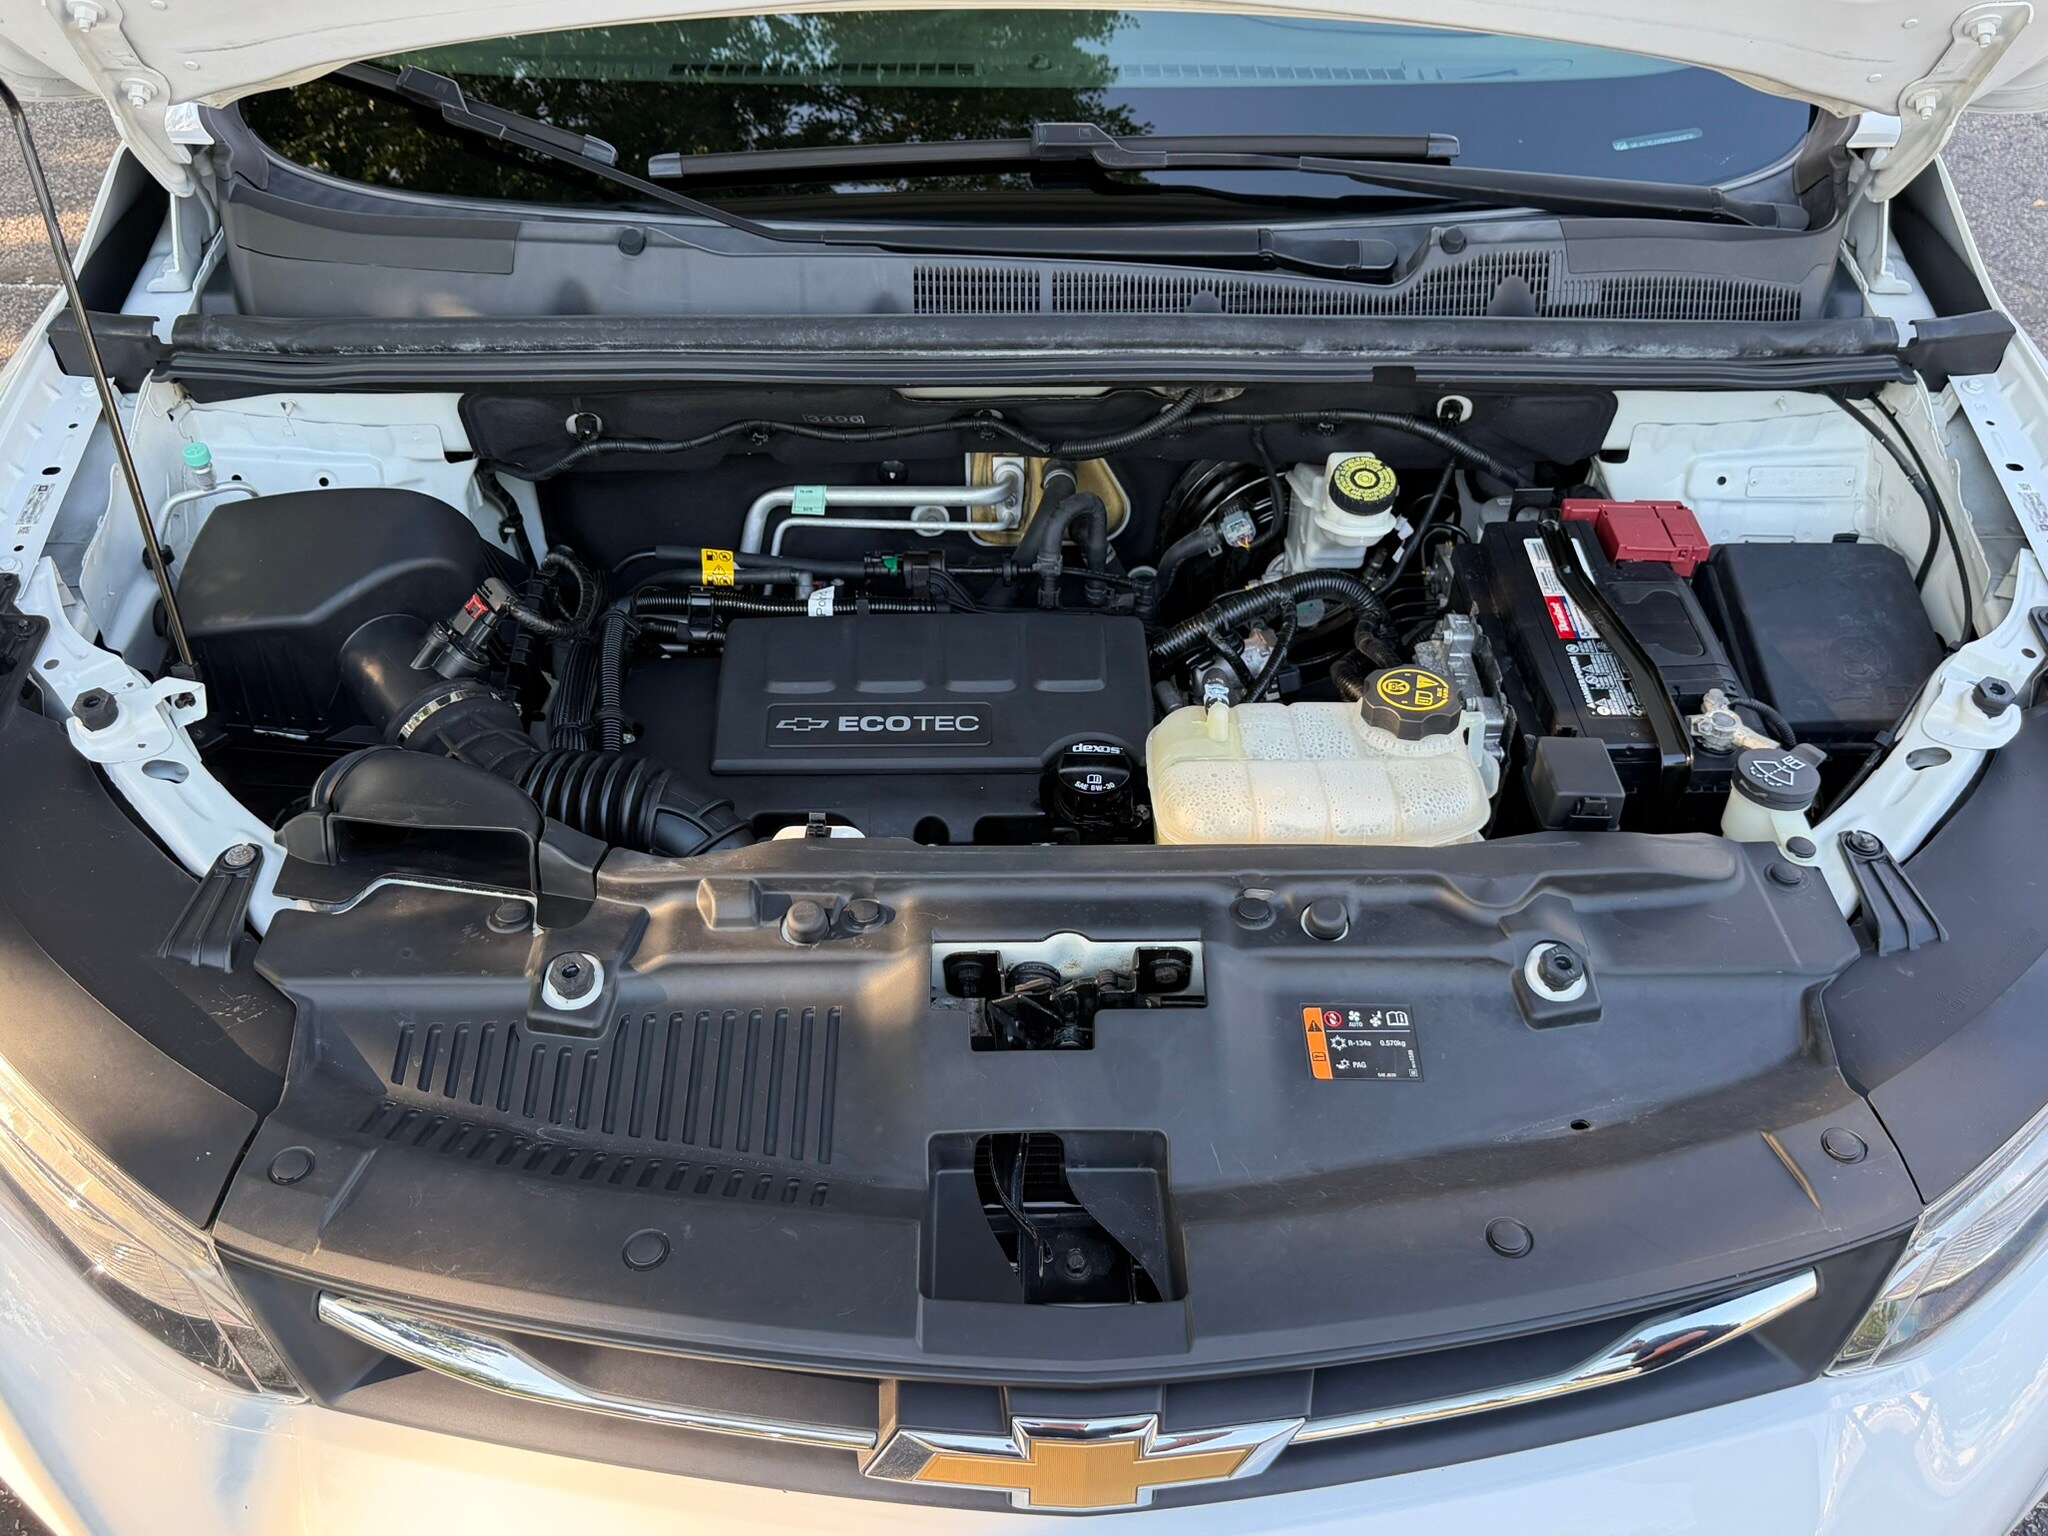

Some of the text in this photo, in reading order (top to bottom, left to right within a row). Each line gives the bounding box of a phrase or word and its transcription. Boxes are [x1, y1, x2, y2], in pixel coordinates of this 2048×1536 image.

[838, 715, 980, 732] ECOTEC
[1072, 743, 1121, 754] dexos
[1074, 780, 1089, 791] SAE
[1347, 1039, 1407, 1048] R-134a 0.570kg
[1352, 1061, 1367, 1069] PAG
